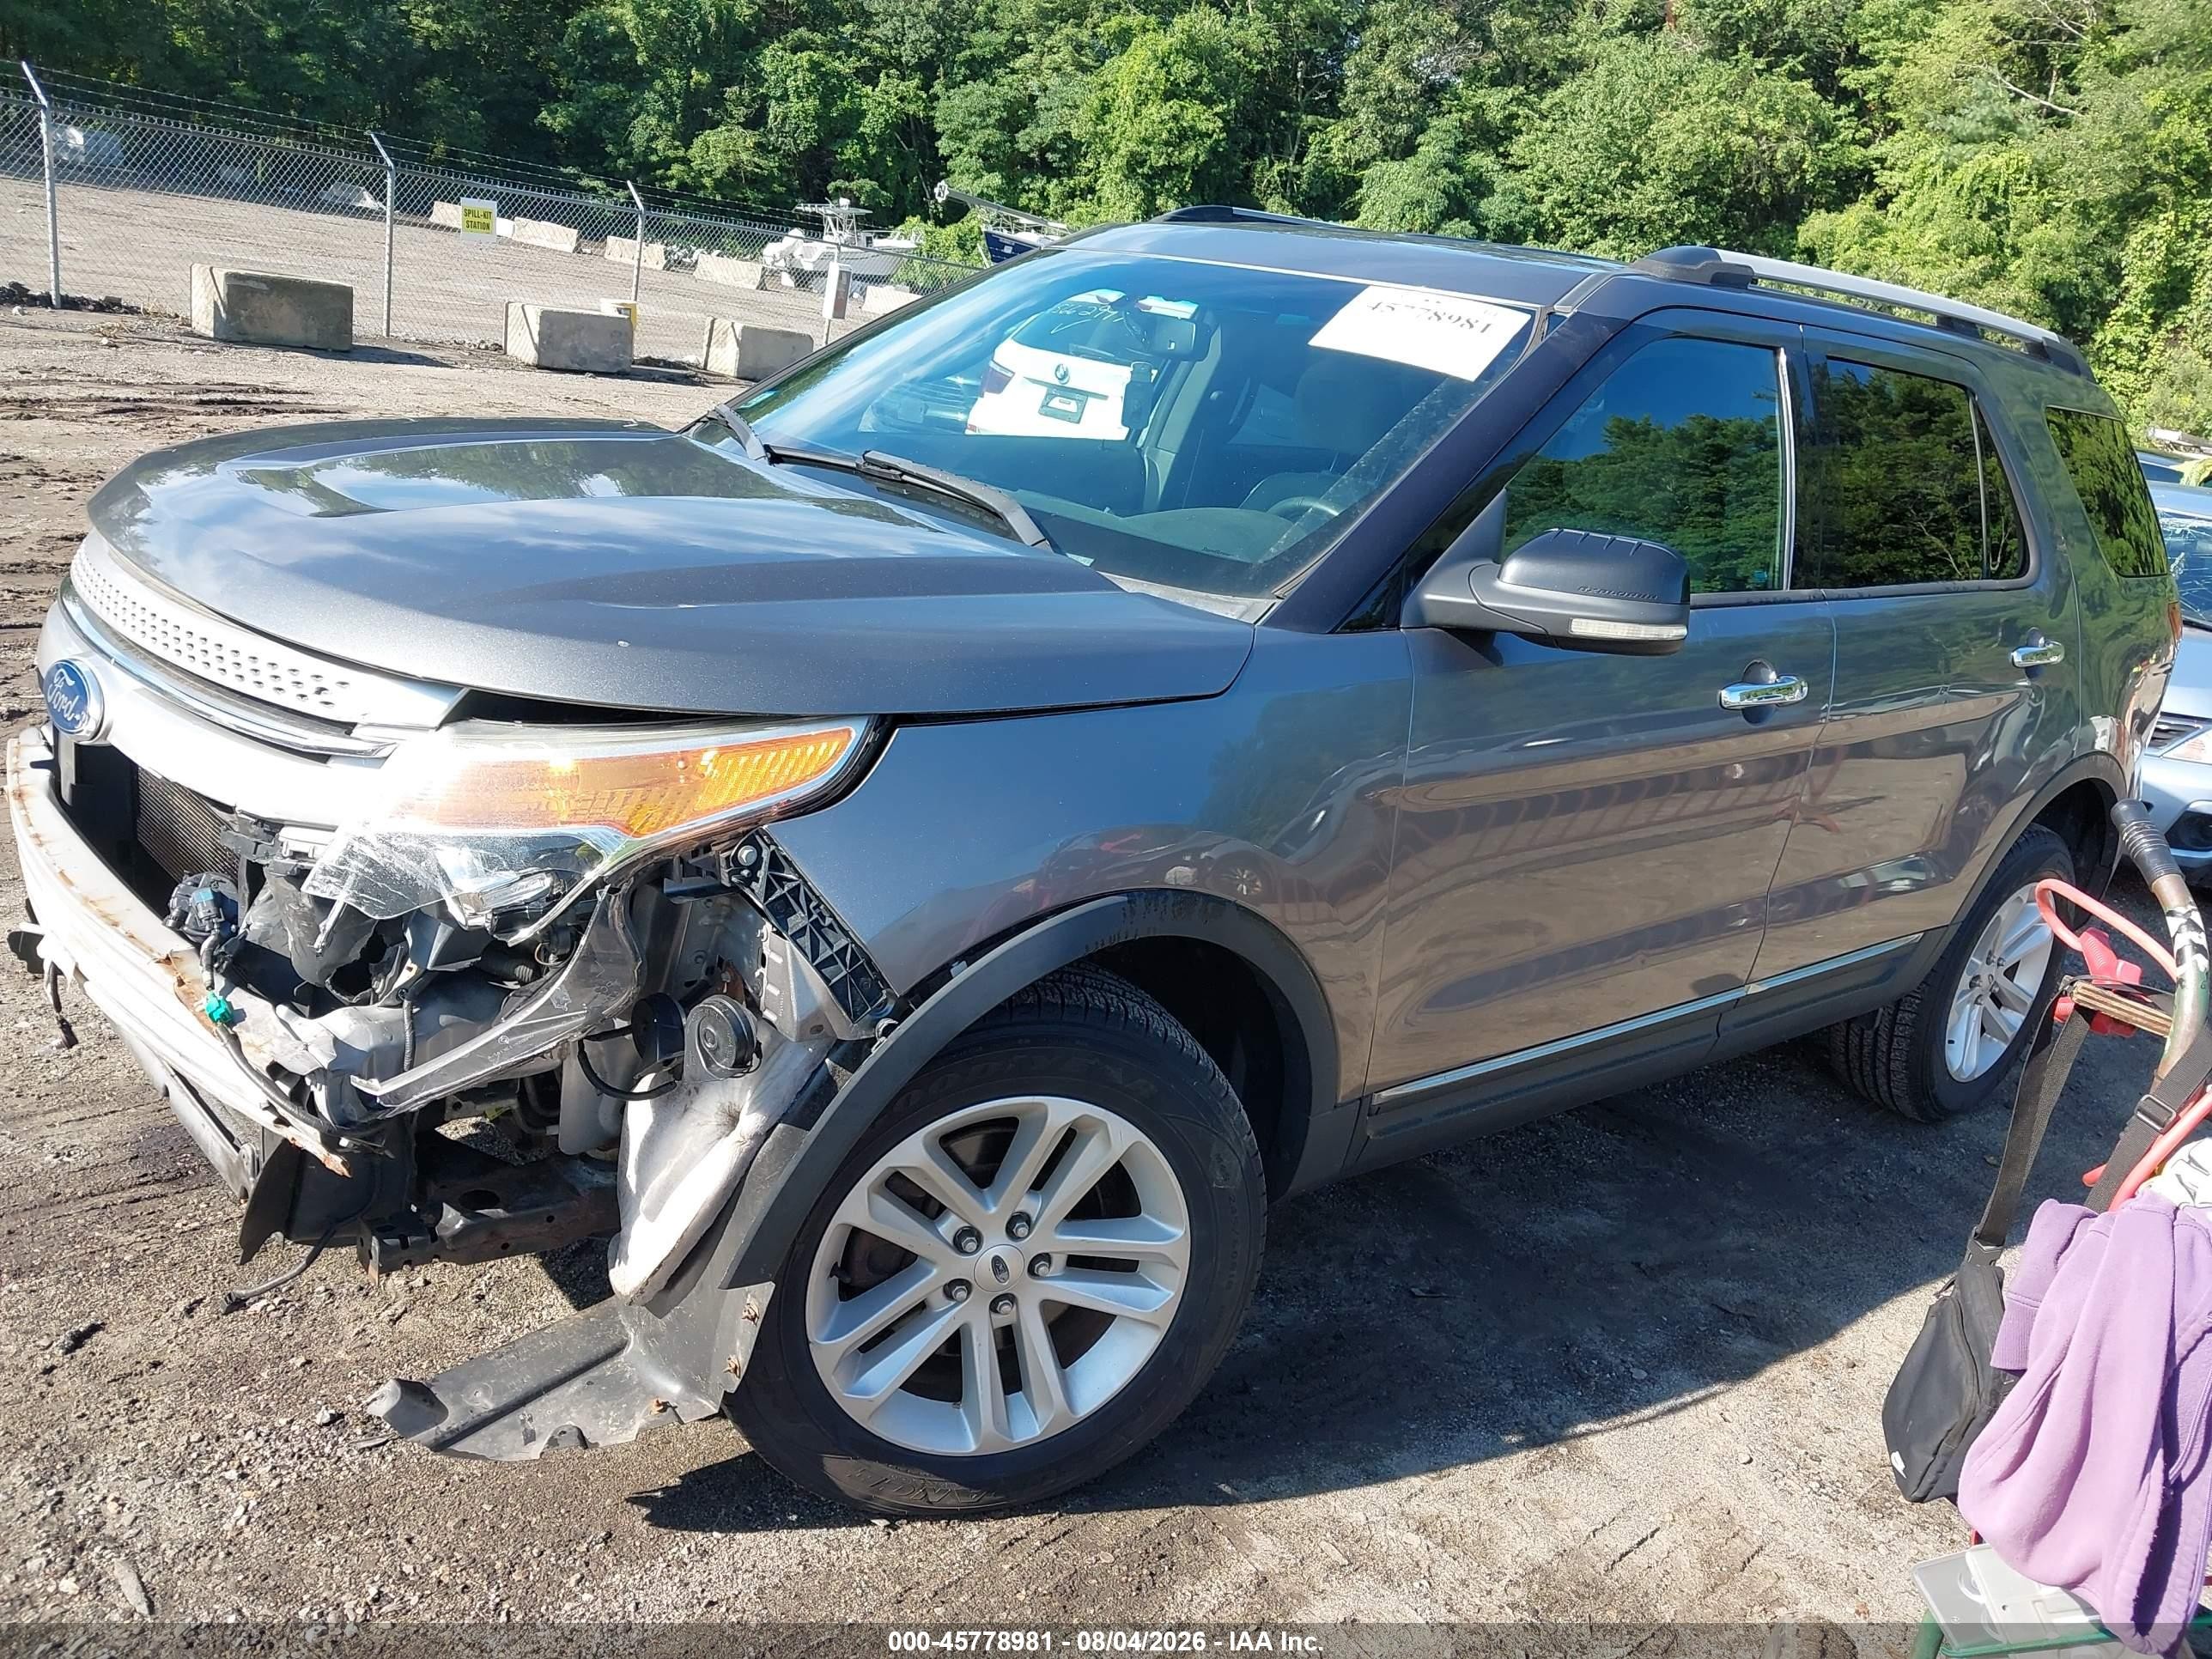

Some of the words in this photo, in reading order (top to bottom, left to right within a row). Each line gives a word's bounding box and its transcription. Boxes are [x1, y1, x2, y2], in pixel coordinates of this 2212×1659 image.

[464, 208, 493, 220] SPILL-KIT
[465, 220, 490, 231] STATION
[47, 668, 80, 721] Ford
